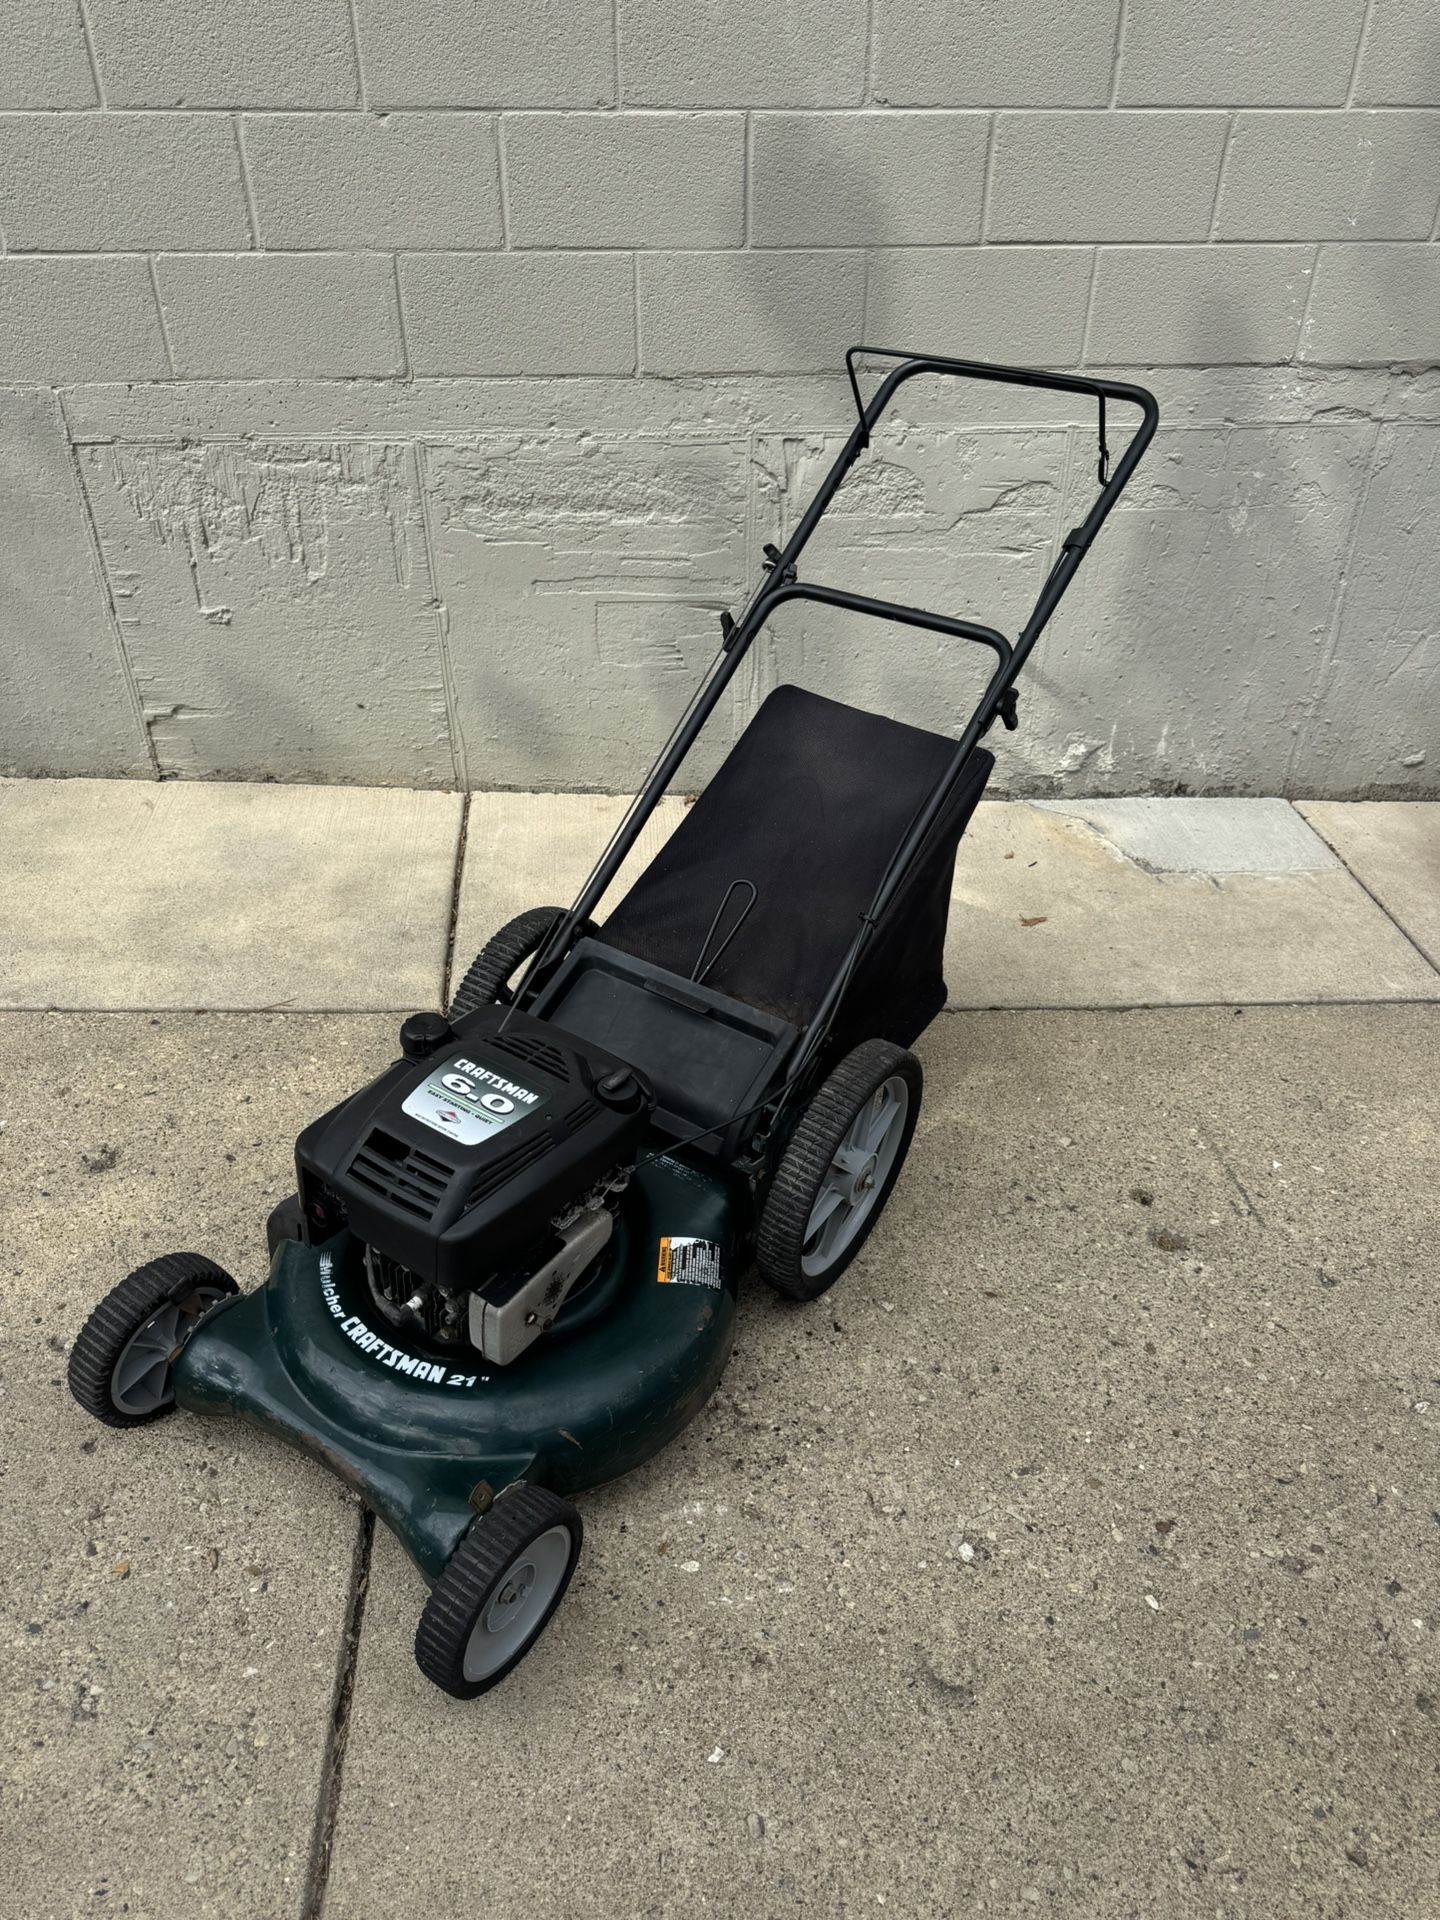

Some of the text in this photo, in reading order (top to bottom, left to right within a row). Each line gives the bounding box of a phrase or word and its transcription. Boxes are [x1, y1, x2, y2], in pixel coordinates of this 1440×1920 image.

[453, 1058, 539, 1105] CRAFTSMAN
[427, 1089, 443, 1100] EASY
[443, 1097, 471, 1115] STARTING
[474, 1114, 493, 1126] QUIET
[320, 1252, 346, 1318] Mulcher
[340, 1316, 447, 1384] CRAFTSMAN
